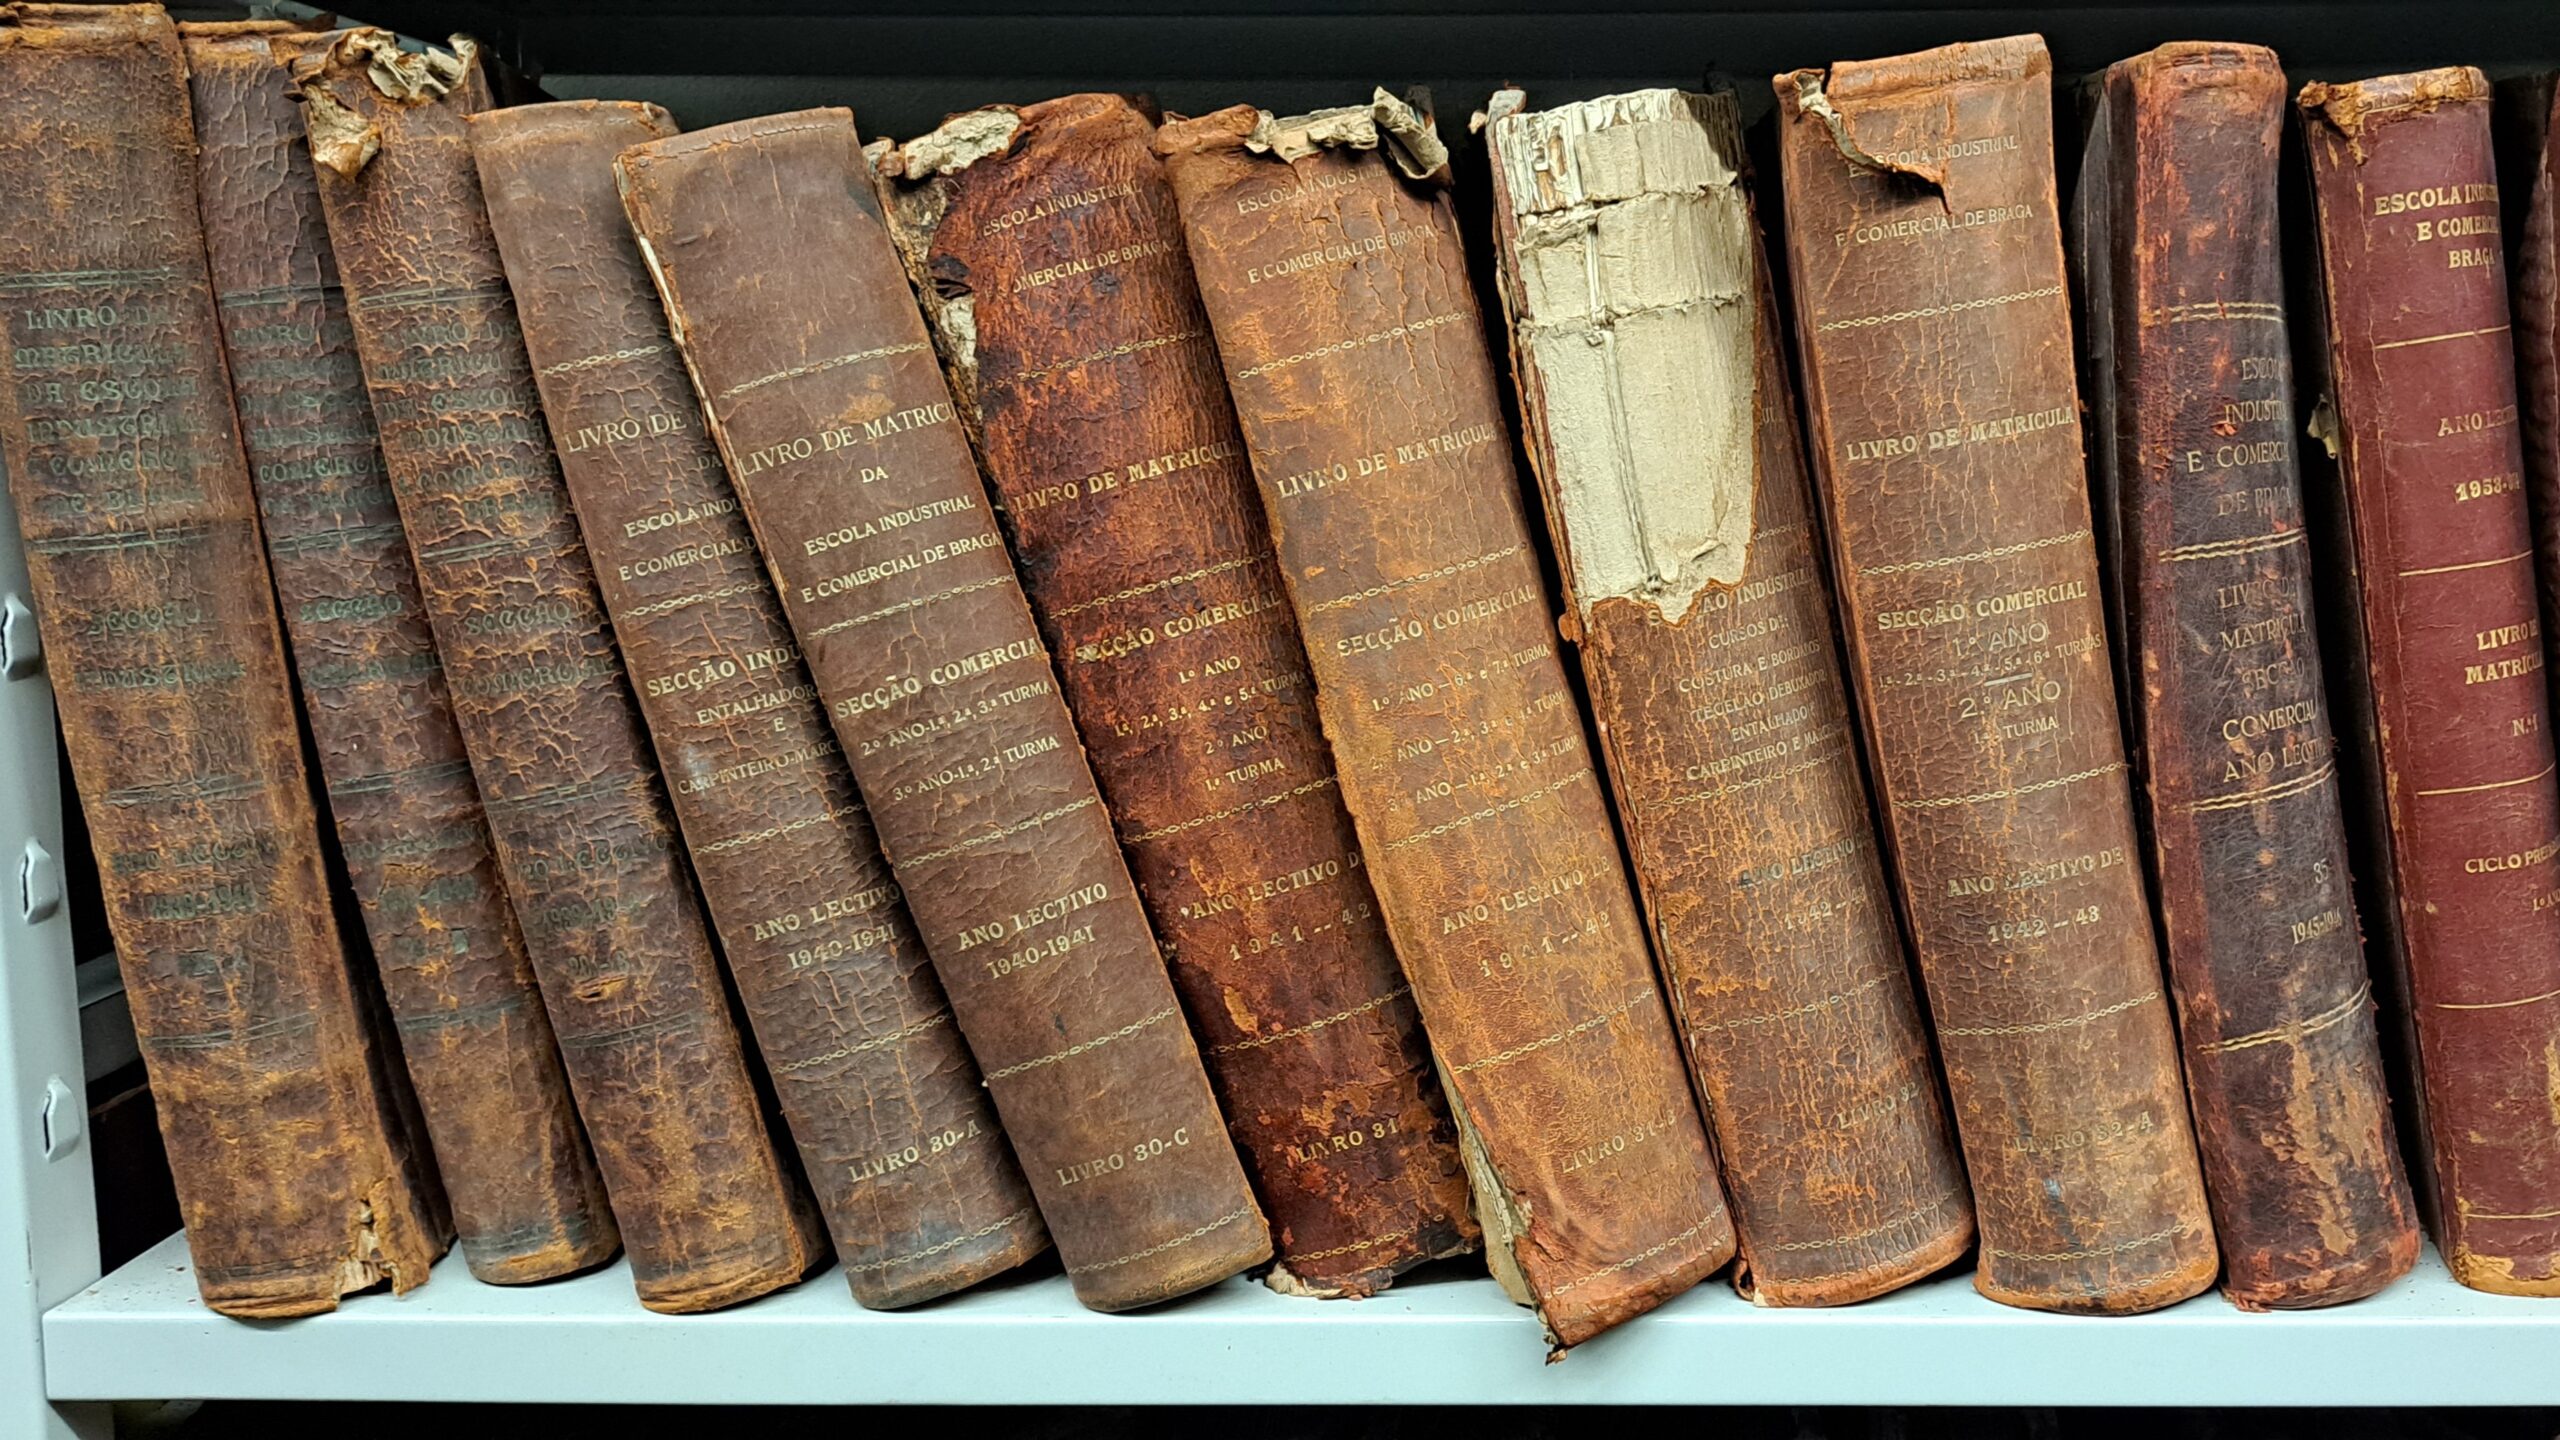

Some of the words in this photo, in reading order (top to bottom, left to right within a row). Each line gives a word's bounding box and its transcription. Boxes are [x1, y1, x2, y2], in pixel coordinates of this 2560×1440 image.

[1937, 135, 2018, 160] INDUSTRIAL
[983, 205, 1045, 237] ESCOLA
[1048, 180, 1141, 212] INDUSTRIAL
[1236, 184, 1305, 215] ESCOLA
[2375, 185, 2462, 216] ESCOLA
[1856, 214, 1961, 244] COMERCIAL
[1964, 210, 1985, 227] DE
[1988, 204, 2033, 224] BRAGA
[2416, 221, 2432, 241] E
[1097, 250, 1119, 268] DE
[1247, 268, 1261, 284] E
[1263, 243, 1362, 279] COMERCIAL
[1364, 236, 1386, 253] DE
[1390, 224, 1435, 247] BRAGA
[2448, 248, 2495, 268] BRAGA
[25, 305, 117, 329] LIVRO
[565, 419, 641, 452] LIVRO
[650, 413, 687, 434] DE
[1846, 435, 1918, 461] LIVRO
[1928, 428, 1960, 450] DE
[1970, 406, 2075, 442] MATRICULA
[2437, 413, 2482, 437] ANO
[697, 456, 723, 470] DA
[738, 438, 812, 477] LIVRO
[820, 426, 857, 451] DE
[1276, 463, 1348, 499] LIVRO
[1356, 452, 1388, 477] DE
[1396, 422, 1497, 465] MATRICULA
[2186, 451, 2205, 473] E
[860, 466, 888, 483] DA
[1014, 482, 1078, 512] LIVRO
[1087, 471, 1118, 494] DE
[2217, 491, 2248, 516] DE
[624, 508, 699, 538] ESCOLA
[804, 522, 877, 556] ESCOLA
[878, 495, 975, 532] INDUSTRIAL
[619, 565, 633, 581] E
[635, 540, 743, 576] COMERCIAL
[801, 587, 815, 603] E
[816, 554, 921, 597] COMERCIAL
[922, 544, 948, 564] DE
[948, 532, 1001, 557] BRAGA
[1163, 590, 1280, 638] COMERCIAL
[1336, 617, 1423, 658] SECÇÃO
[1432, 584, 1537, 631] COMERCIAL
[1878, 599, 1966, 630] SECÇÃO
[1976, 580, 2088, 618] COMERCIAL
[1709, 620, 1766, 649] CURSOS
[1989, 622, 2048, 652] ANO
[2476, 623, 2528, 651] LIVRO
[1204, 655, 1241, 677] ANO
[1513, 644, 1551, 667] TURMA
[647, 660, 736, 697] SECÇÃO
[1679, 663, 1753, 693] COSTURA
[1758, 657, 1767, 671] E
[835, 675, 922, 720] SECÇÃO
[999, 681, 1052, 707] TURMA
[2003, 680, 2061, 711] ANO
[774, 717, 786, 732] E
[1231, 725, 1268, 747] ANO
[1397, 739, 1432, 762] ANO
[1535, 690, 1567, 713] TURM
[2003, 716, 2058, 740] TURMA
[2222, 699, 2318, 741] COMERCIAL
[1003, 736, 1060, 764] TURMA
[1686, 741, 1787, 781] CARPINTEIRO
[1792, 737, 1800, 750] E
[2223, 751, 2274, 783] ANO
[1225, 757, 1285, 784] TURMA
[1417, 782, 1451, 803] ANO
[1550, 735, 1580, 756] TURM
[1948, 876, 1994, 897] ANO
[2004, 855, 2095, 890] LECTIVO
[2100, 847, 2125, 868] DE
[2465, 854, 2521, 873] CICLO
[1192, 894, 1236, 919] ANO
[1247, 860, 1338, 901] LECTIVO
[754, 914, 800, 941] ANO
[809, 883, 900, 924] LECTIVO
[958, 921, 1004, 951] ANO
[1011, 882, 1108, 931] LECTIVO
[1442, 904, 1489, 935] ANO
[787, 924, 896, 970] 1940-1941
[986, 925, 1096, 979] 1940-1941
[1371, 1117, 1400, 1139] 31
[1837, 1095, 1896, 1129] LIVRO
[849, 1145, 919, 1183] LIVRO
[930, 1120, 981, 1154] 30-A
[1056, 1153, 1124, 1186] LIVRO
[1133, 1127, 1189, 1162] 30-C
[1561, 1135, 1625, 1173] LIVRO
